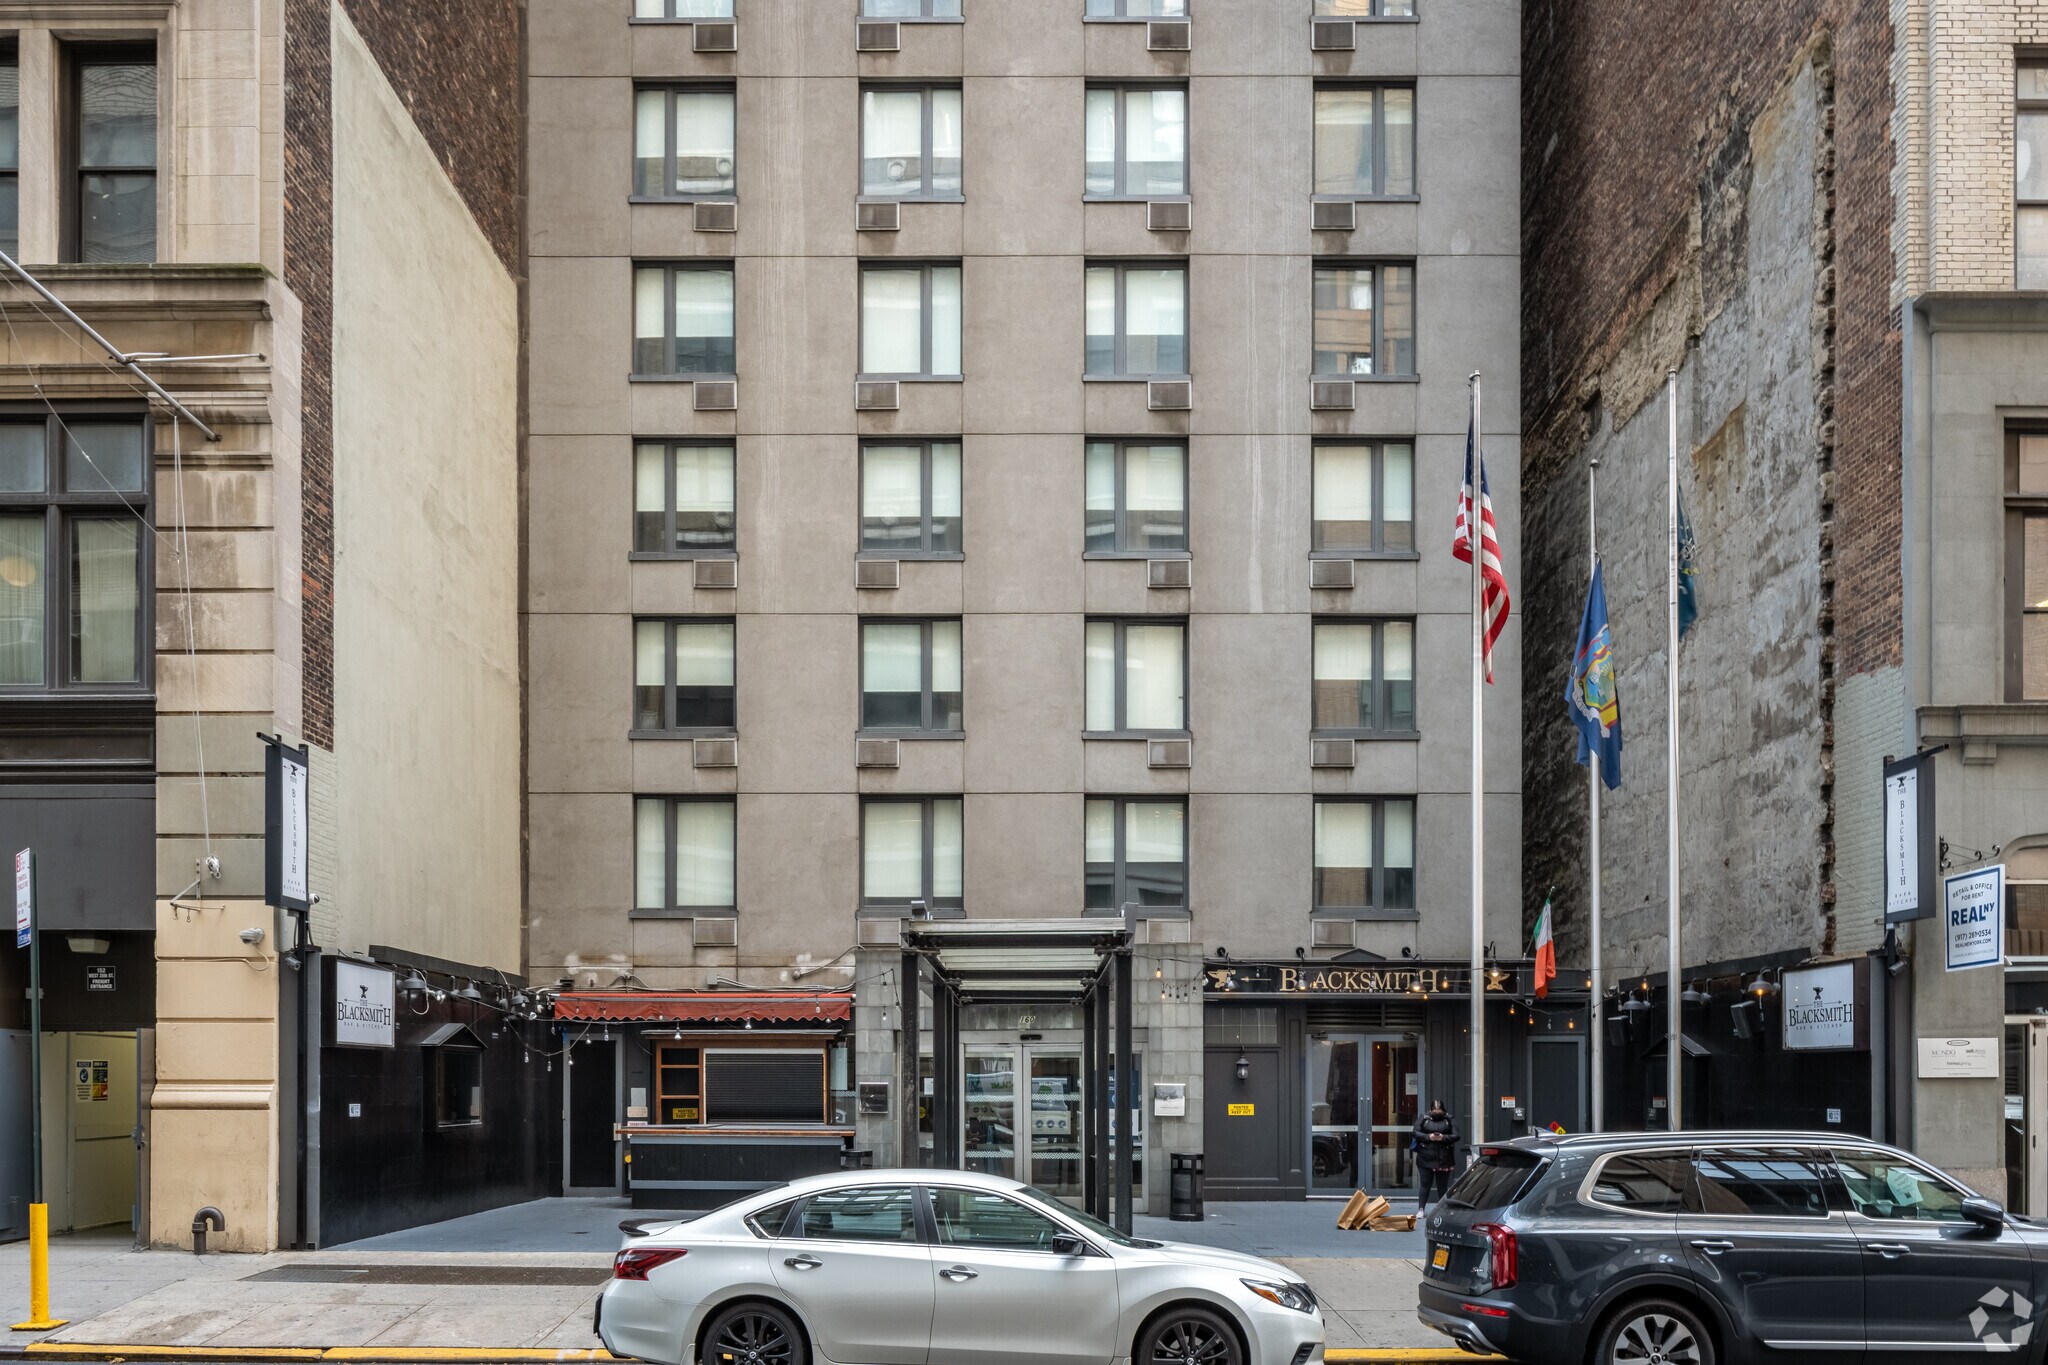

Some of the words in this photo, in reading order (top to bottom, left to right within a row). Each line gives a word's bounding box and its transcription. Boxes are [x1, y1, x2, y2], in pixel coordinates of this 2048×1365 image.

[1897, 787, 1906, 795] THE
[1952, 886, 1969, 898] RETAIL
[1971, 891, 1984, 899] RENT
[1279, 967, 1440, 993] BACKSMITH
[1813, 1000, 1824, 1008] THE
[337, 1002, 392, 1026] BLACKSMITH
[1020, 1015, 1036, 1023] 160
[1788, 1003, 1853, 1027] BLACKSMITH
